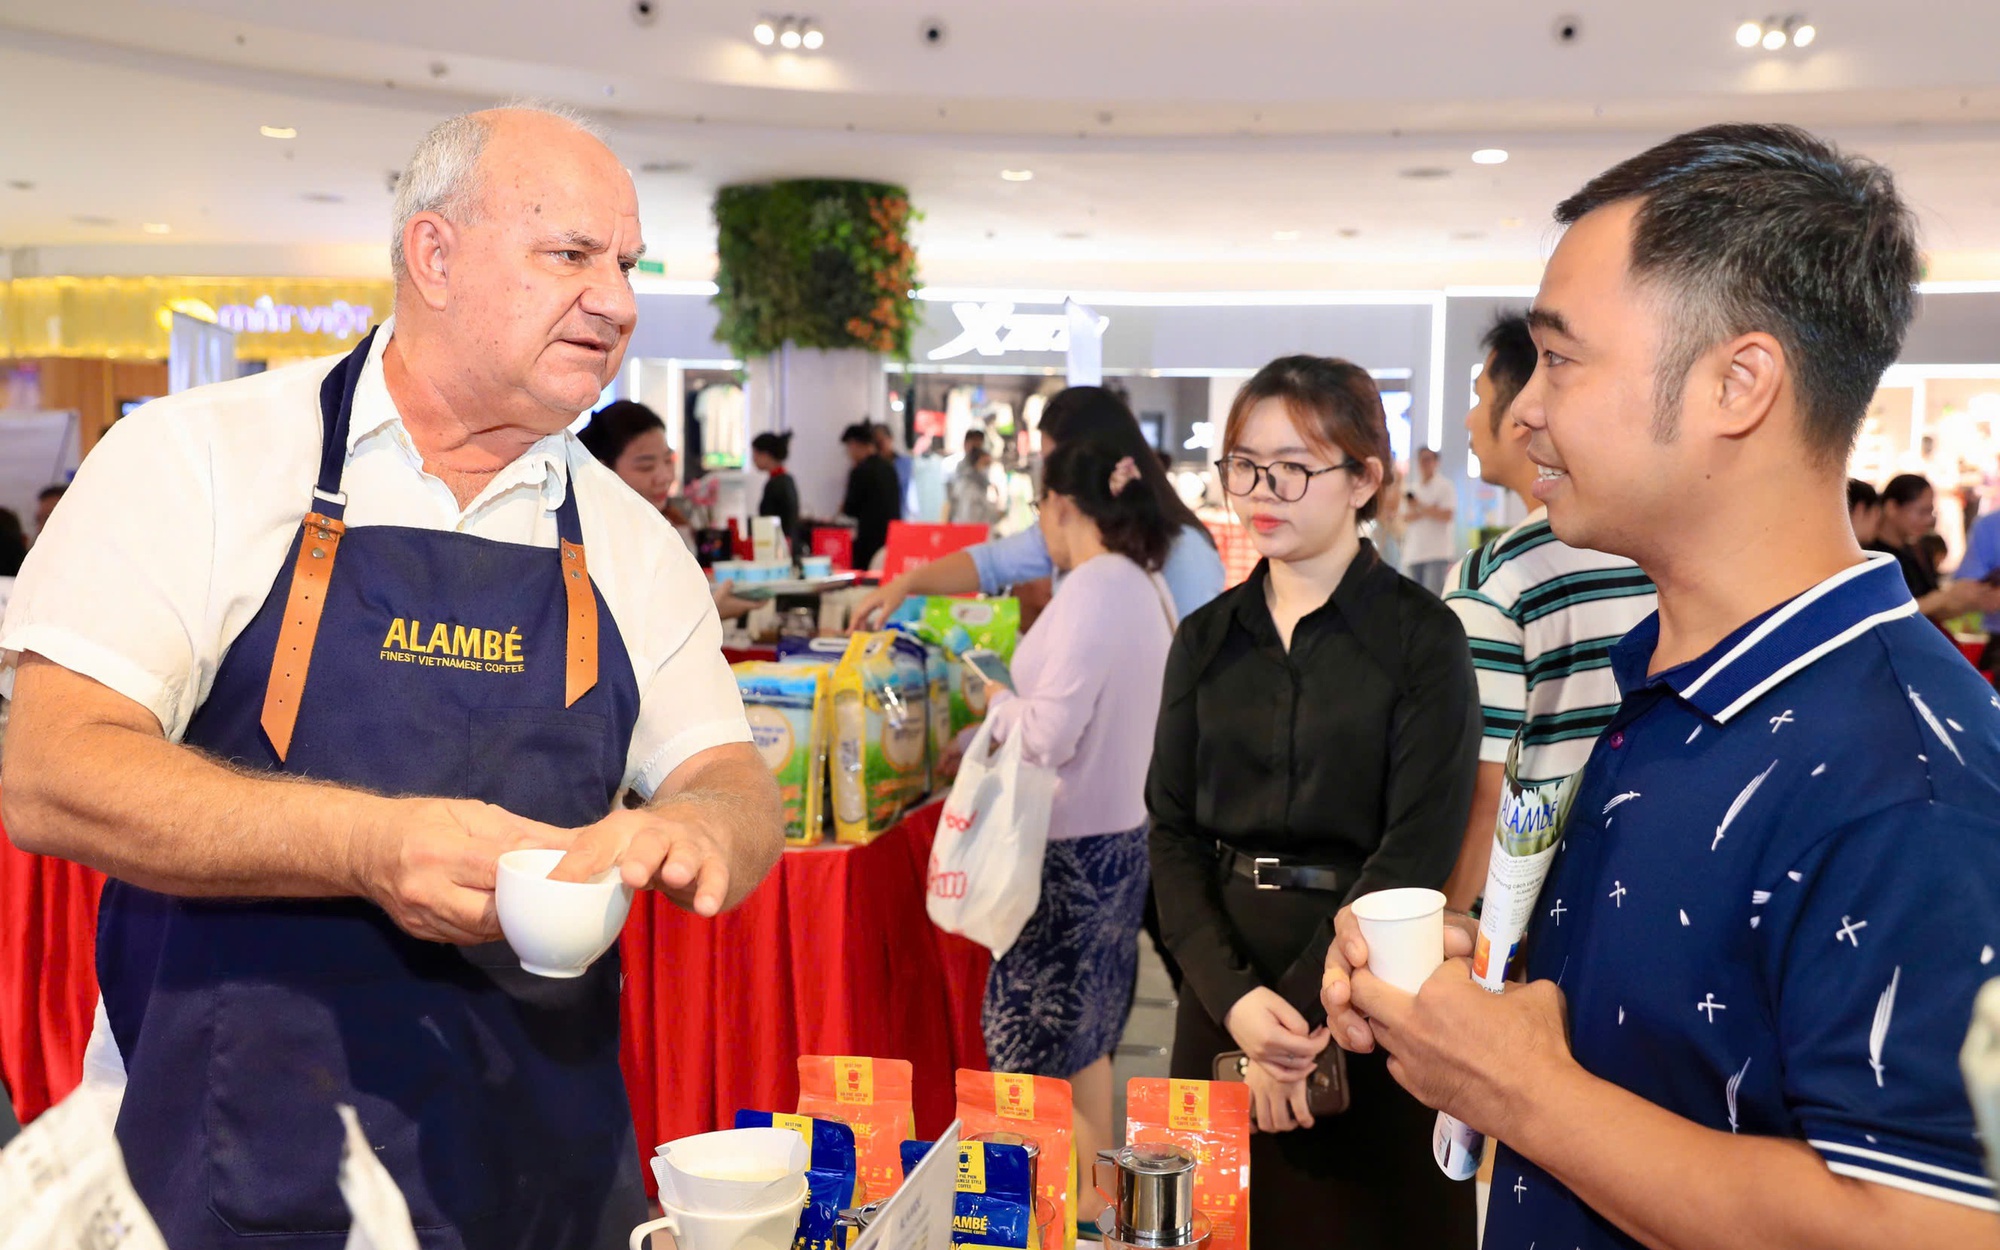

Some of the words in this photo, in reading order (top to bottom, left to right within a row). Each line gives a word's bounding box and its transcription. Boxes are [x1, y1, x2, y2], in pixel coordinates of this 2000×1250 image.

[383, 617, 524, 663] ALAMBÉ
[380, 651, 416, 664] FINEST
[418, 655, 482, 672] VIETNAMESE
[485, 663, 525, 673] COFFEE
[953, 1215, 988, 1231] AMBÉ
